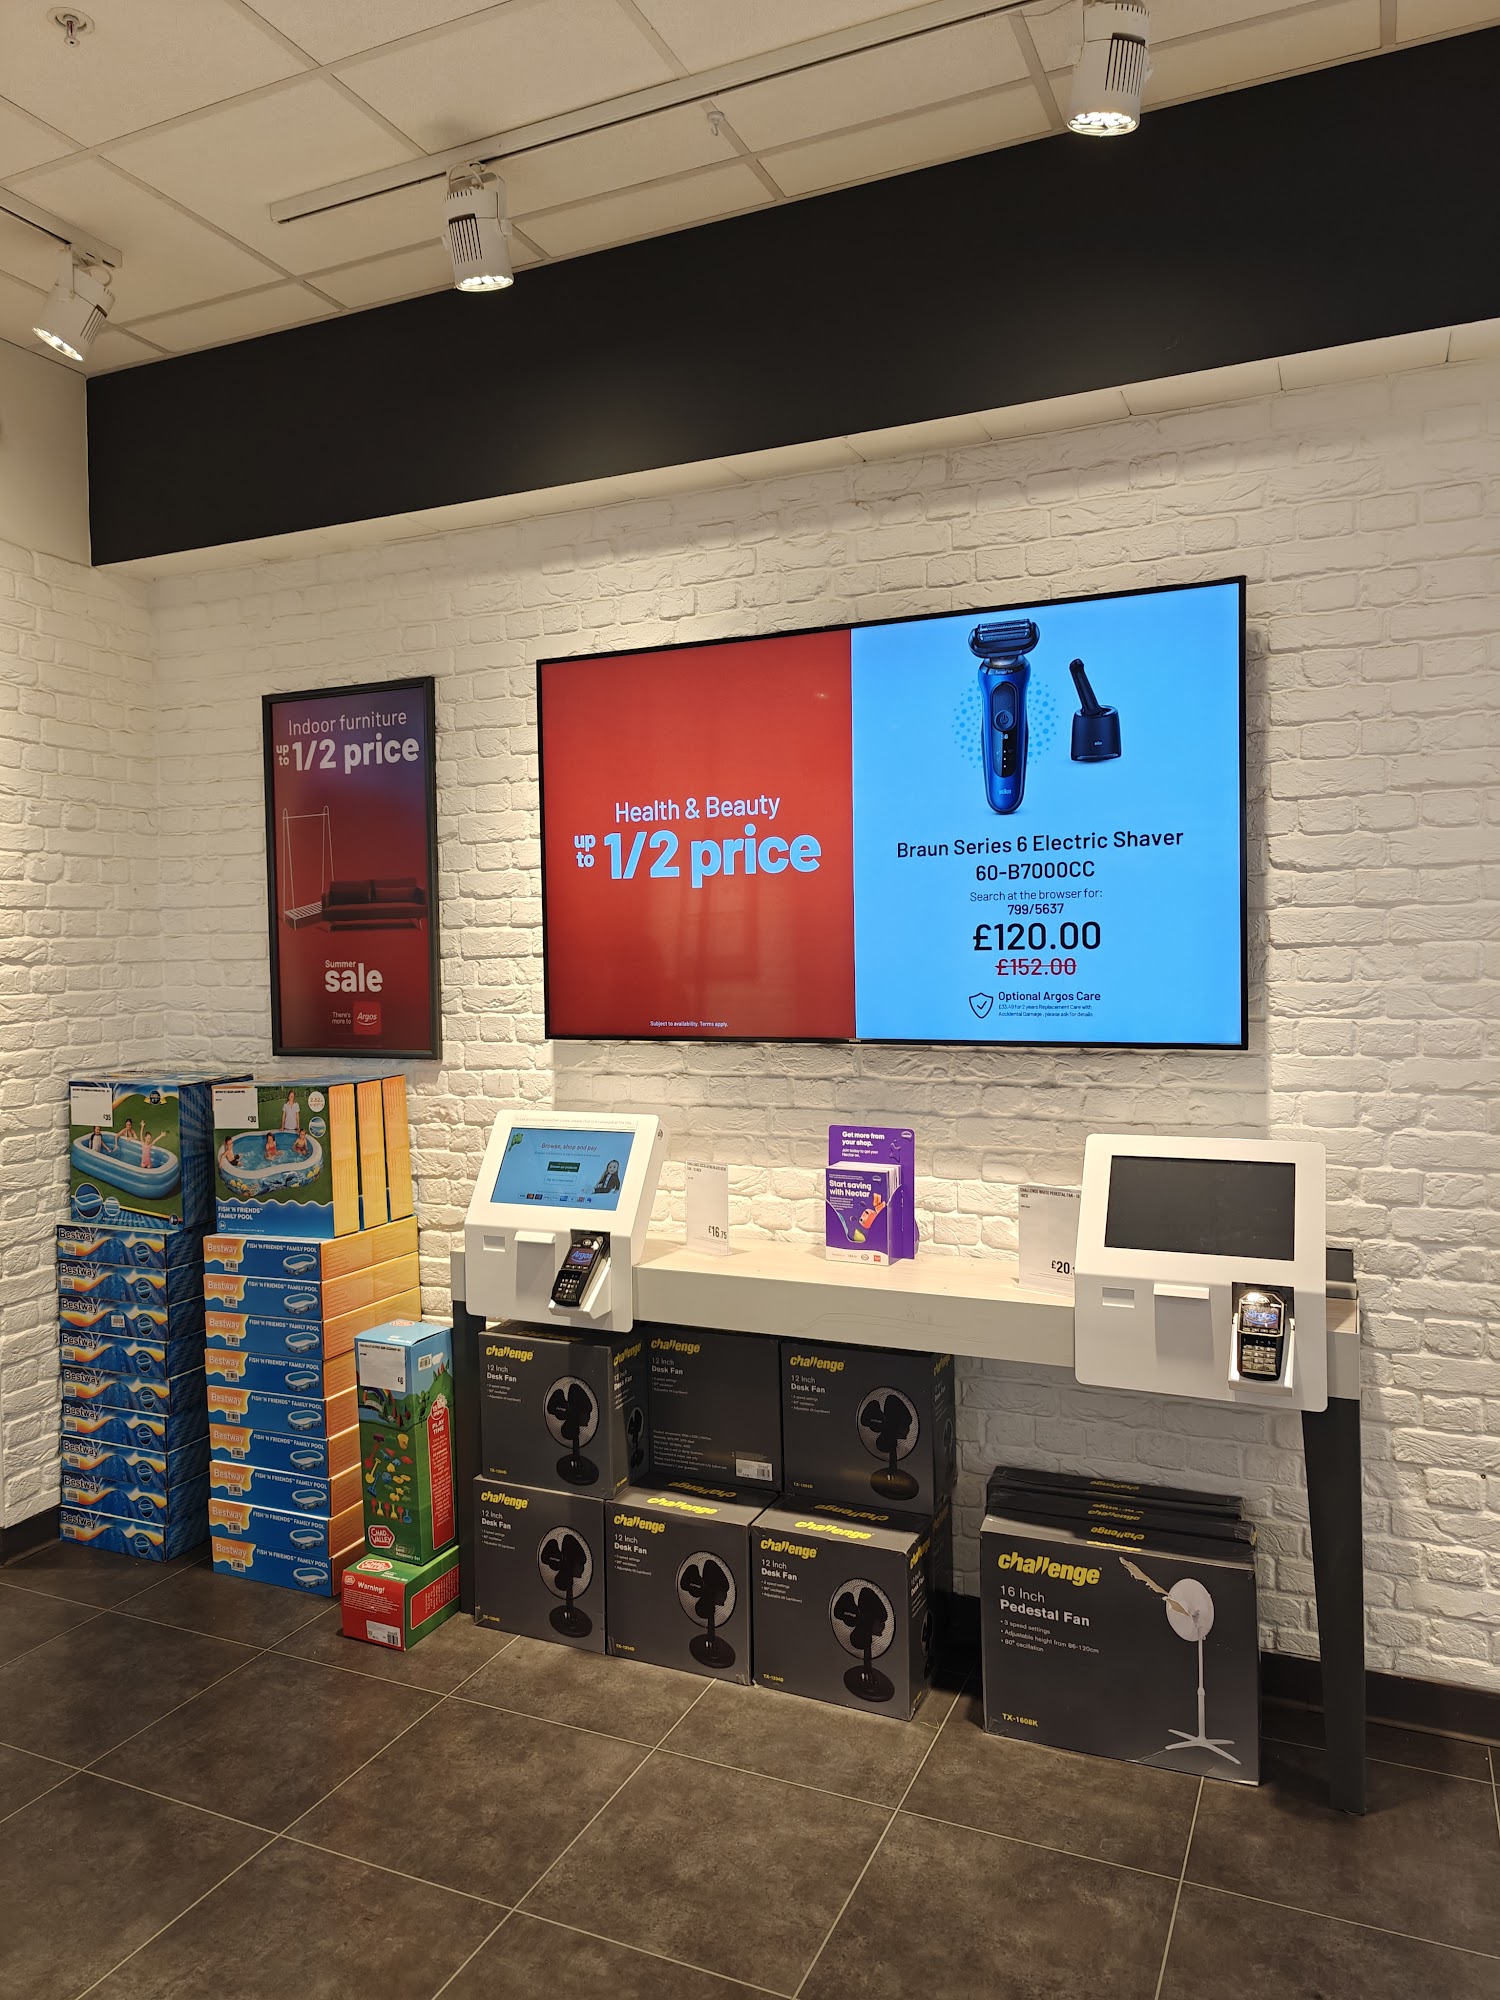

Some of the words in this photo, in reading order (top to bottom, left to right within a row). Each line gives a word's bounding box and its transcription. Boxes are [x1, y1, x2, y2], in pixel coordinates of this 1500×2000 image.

[288, 716, 336, 737] Indoor
[340, 710, 407, 732] furniture
[276, 743, 289, 756] up
[292, 739, 336, 771] 1/2
[345, 733, 420, 774] price
[278, 755, 290, 766] to
[615, 799, 680, 823] Health
[685, 797, 700, 819] &
[706, 794, 781, 820] Beauty
[574, 834, 596, 851] up
[897, 842, 949, 858] Braun
[954, 837, 1012, 856] Series
[1017, 836, 1027, 852] 6
[1033, 831, 1108, 851] Electric
[1113, 830, 1183, 848] Shaver
[576, 852, 594, 867] to
[604, 830, 680, 879] 1/2
[691, 823, 822, 889] price
[975, 860, 1095, 881] 60-B7000CC
[969, 890, 1006, 902] Search
[1008, 891, 1018, 901] at
[1019, 889, 1037, 901] the
[1038, 888, 1082, 900] browser
[1083, 887, 1103, 899] for:
[1007, 902, 1064, 916] 799/5637
[972, 921, 1101, 951] £120.00
[325, 960, 356, 968] Summer
[996, 957, 1077, 976] £152.00
[324, 963, 383, 992] sale
[998, 991, 1041, 1003] Optional
[1043, 991, 1074, 1003] Argos
[1076, 991, 1101, 1001] Care
[357, 1012, 377, 1022] Argos
[650, 1020, 667, 1028] Subject
[842, 1131, 854, 1139] Get
[562, 1143, 576, 1151] shop
[842, 1139, 856, 1147] your
[856, 1140, 874, 1148] shop.
[829, 1179, 847, 1188] Start
[847, 1181, 872, 1191] saving
[829, 1188, 845, 1196] with
[844, 1189, 871, 1198] Nectar
[58, 1228, 96, 1243] Bestway
[708, 1225, 728, 1240] £16.75
[207, 1243, 238, 1254] Bestway
[572, 1251, 593, 1260] Argos
[61, 1263, 97, 1279] Bestway
[207, 1281, 238, 1291] Bestway
[1247, 1309, 1277, 1321] Argos
[62, 1334, 98, 1349] Bestway
[651, 1338, 701, 1355] challenge
[485, 1345, 534, 1362] challenge
[613, 1342, 642, 1367] challenge
[208, 1356, 239, 1367] Bestway
[652, 1357, 660, 1365] 12
[661, 1358, 675, 1366] Inch
[790, 1355, 845, 1373] challenge
[495, 1365, 509, 1373] Inch
[651, 1365, 669, 1373] Desk
[670, 1367, 684, 1375] Fan
[486, 1372, 503, 1381] Desk
[504, 1374, 517, 1382] Fan
[791, 1374, 800, 1382] 12
[801, 1375, 816, 1384] Inch
[790, 1383, 810, 1392] Desk
[811, 1385, 826, 1394] Fan
[64, 1404, 99, 1421] Bestway
[432, 1419, 445, 1429] PLAY
[432, 1426, 444, 1435] TIME
[213, 1431, 244, 1443] Bestway
[668, 1481, 737, 1498] challenge
[481, 1491, 529, 1510] challenge
[646, 1497, 718, 1515] challenge
[61, 1511, 97, 1529] Bestway
[482, 1509, 490, 1517] 12
[490, 1510, 503, 1520] Inch
[814, 1504, 890, 1522] challenge
[481, 1518, 498, 1528] Desk
[498, 1520, 512, 1530] Fan
[614, 1514, 665, 1534] challenge
[794, 1519, 872, 1540] challenge
[371, 1527, 387, 1537] CHAD
[615, 1533, 623, 1542] 12
[624, 1535, 638, 1544] Inch
[1090, 1526, 1145, 1541] challenge
[371, 1535, 392, 1545] VALLEY
[216, 1544, 248, 1557] Bestway
[614, 1542, 632, 1552] Desk
[633, 1545, 648, 1555] Fan
[760, 1538, 817, 1560] challenge
[761, 1559, 771, 1567] 12
[772, 1560, 787, 1570] Inch
[998, 1551, 1100, 1587] challenge
[761, 1567, 781, 1578] Desk
[782, 1571, 798, 1581] Fan
[357, 1581, 386, 1594] Warning!
[1000, 1584, 1016, 1597] 16
[1019, 1587, 1045, 1603] Inch
[1000, 1598, 1059, 1621] Pedestal
[1063, 1611, 1090, 1627] Fan
[1009, 1622, 1027, 1630] speed
[1028, 1624, 1051, 1635] settings
[1004, 1629, 1034, 1641] Adjustable
[1034, 1635, 1053, 1645] height
[1053, 1639, 1067, 1648] from
[1015, 1641, 1044, 1652] oscillation
[1002, 1712, 1039, 1728] TX-1608K
